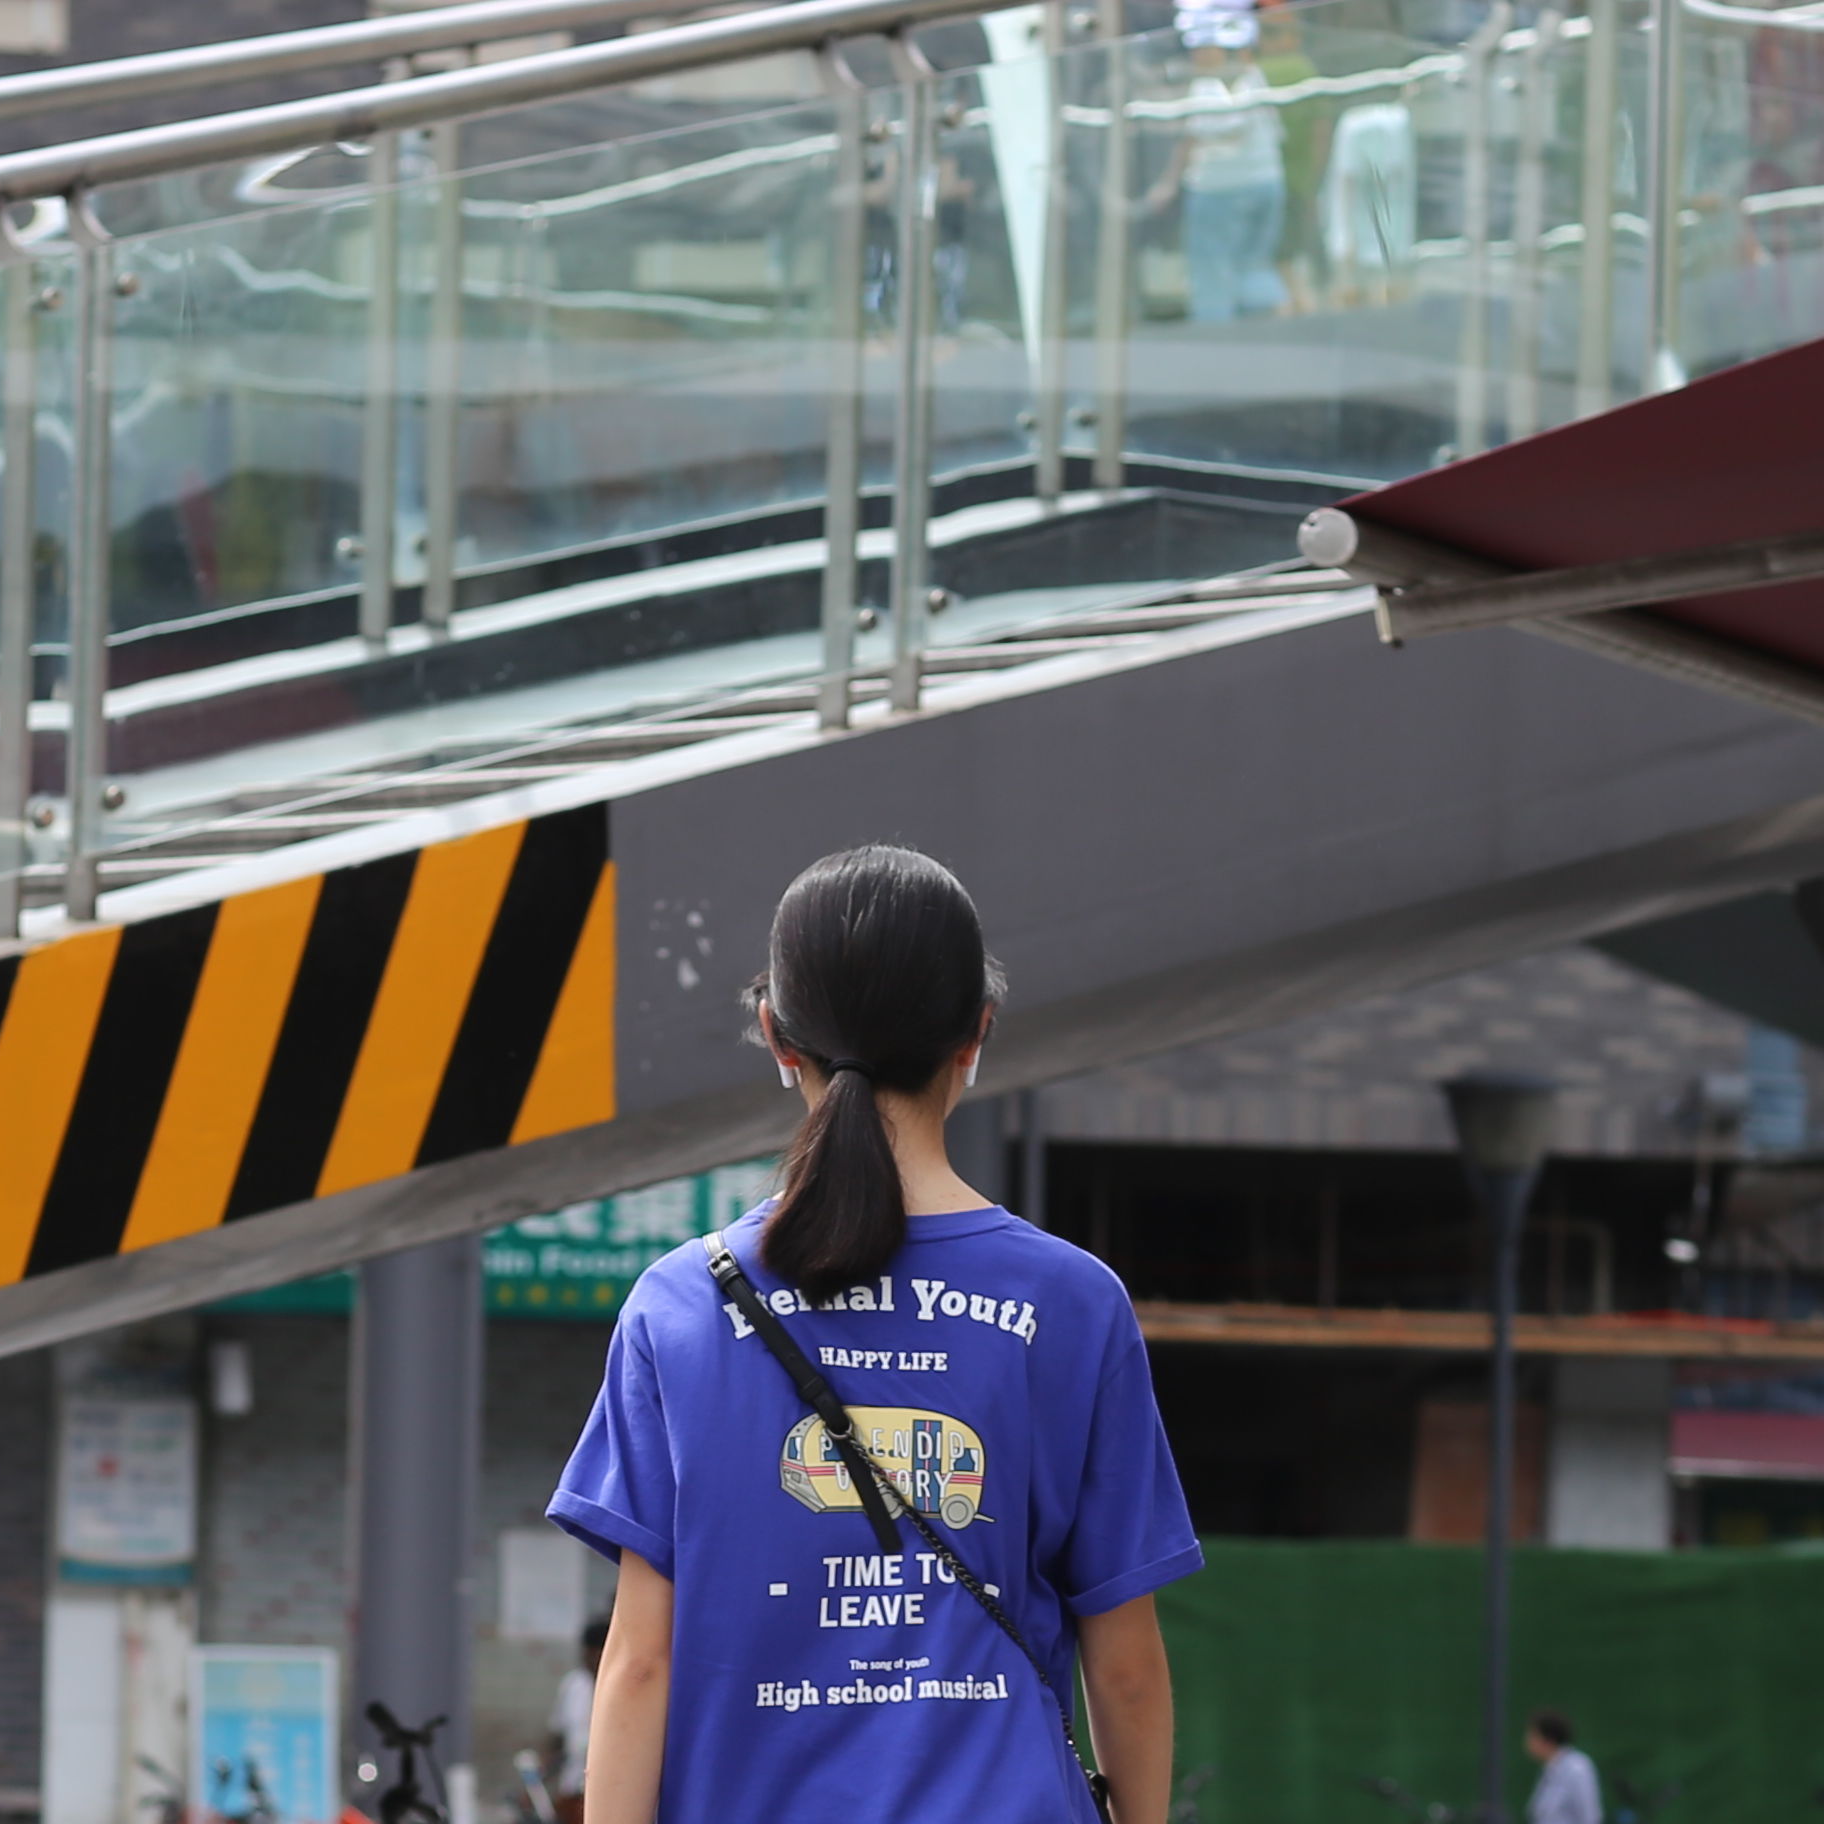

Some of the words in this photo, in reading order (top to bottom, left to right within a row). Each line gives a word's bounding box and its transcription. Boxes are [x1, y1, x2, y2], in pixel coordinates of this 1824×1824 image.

[911, 1278, 1037, 1345] Youth
[819, 1347, 893, 1369] HAPPY
[898, 1352, 948, 1371] LIFE
[823, 1555, 903, 1587] TIME
[819, 1593, 924, 1628] LEAVE
[849, 1659, 868, 1671] The
[870, 1661, 893, 1671] song
[894, 1658, 904, 1669] of
[905, 1657, 930, 1671] youth
[756, 1680, 820, 1712] High
[827, 1677, 912, 1705] school
[917, 1674, 1008, 1700] musical
